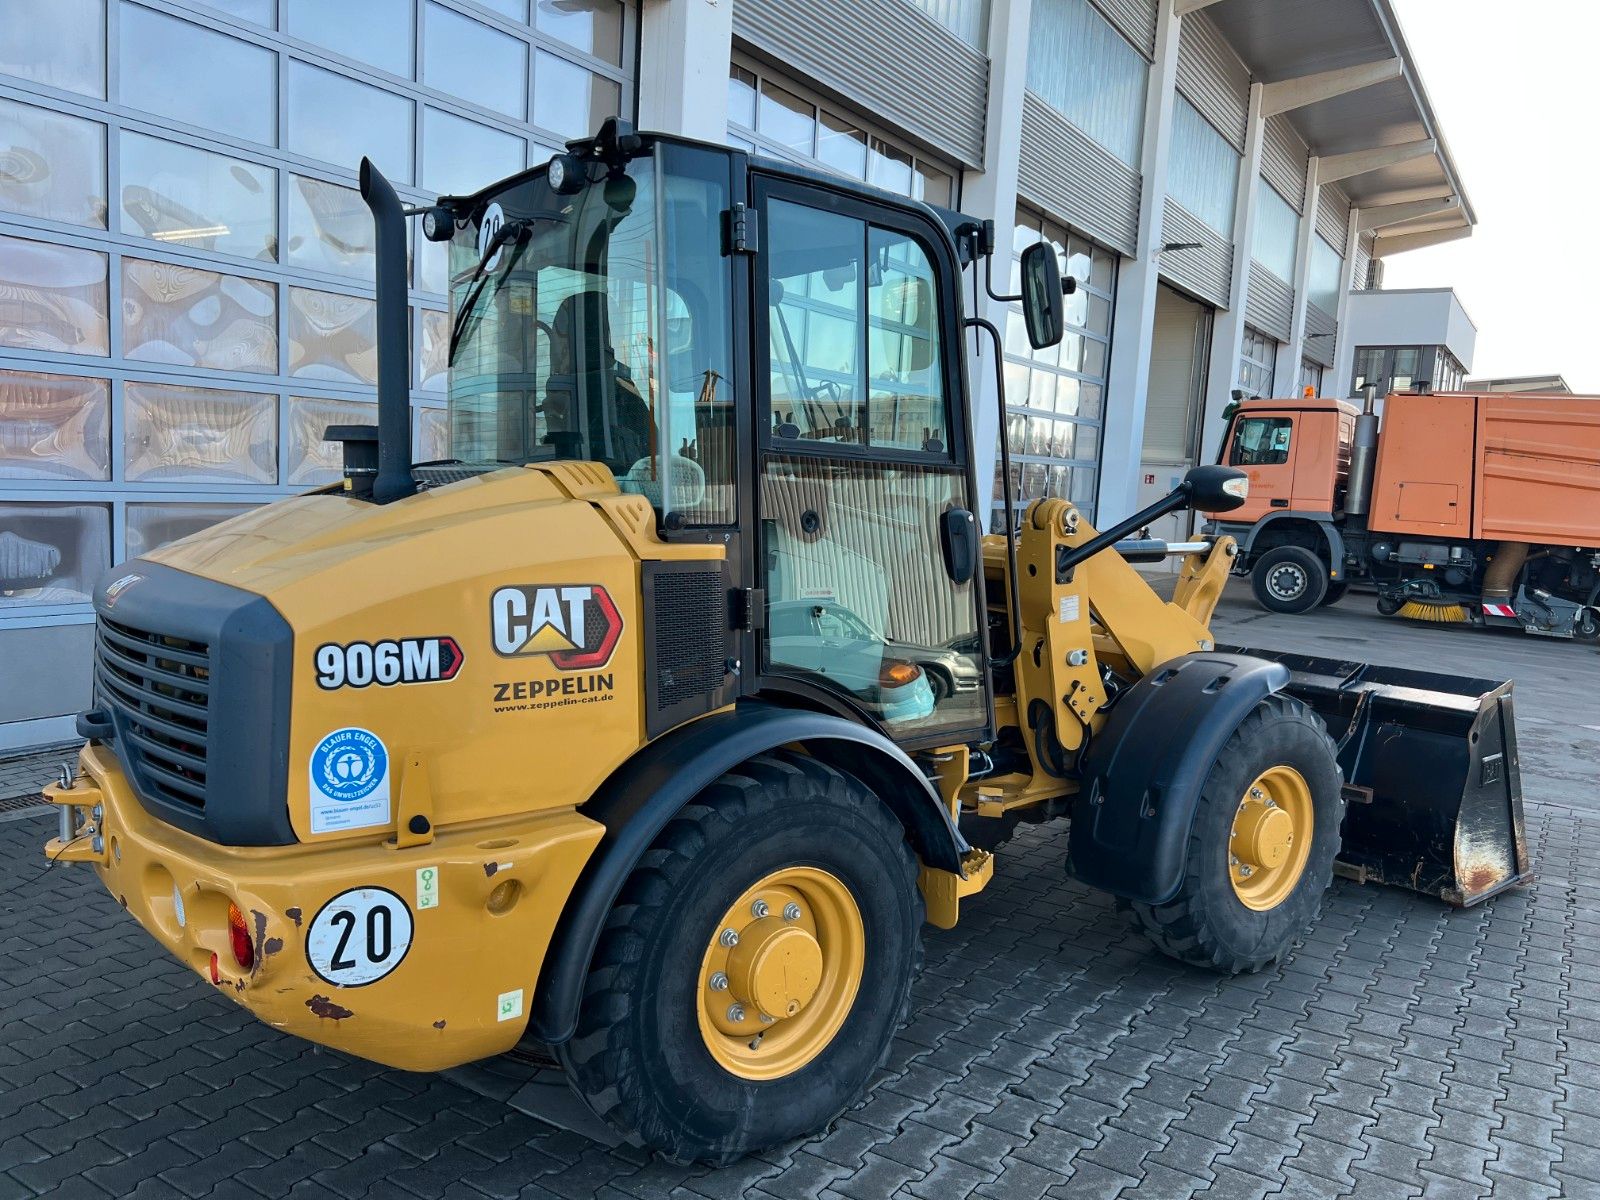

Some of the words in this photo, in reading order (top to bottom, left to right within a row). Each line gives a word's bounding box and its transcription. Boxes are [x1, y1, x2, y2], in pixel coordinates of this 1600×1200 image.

[493, 587, 592, 654] CAT
[317, 639, 440, 688] 906M
[493, 673, 613, 702] ZEPPELIN
[494, 694, 614, 713] www.zeppelin-cat.de
[321, 732, 352, 753] BLAUER
[354, 732, 377, 750] ENGEL
[322, 783, 333, 795] DAS
[333, 778, 378, 799] UMWELTZEICHEN
[330, 904, 392, 972] 20
